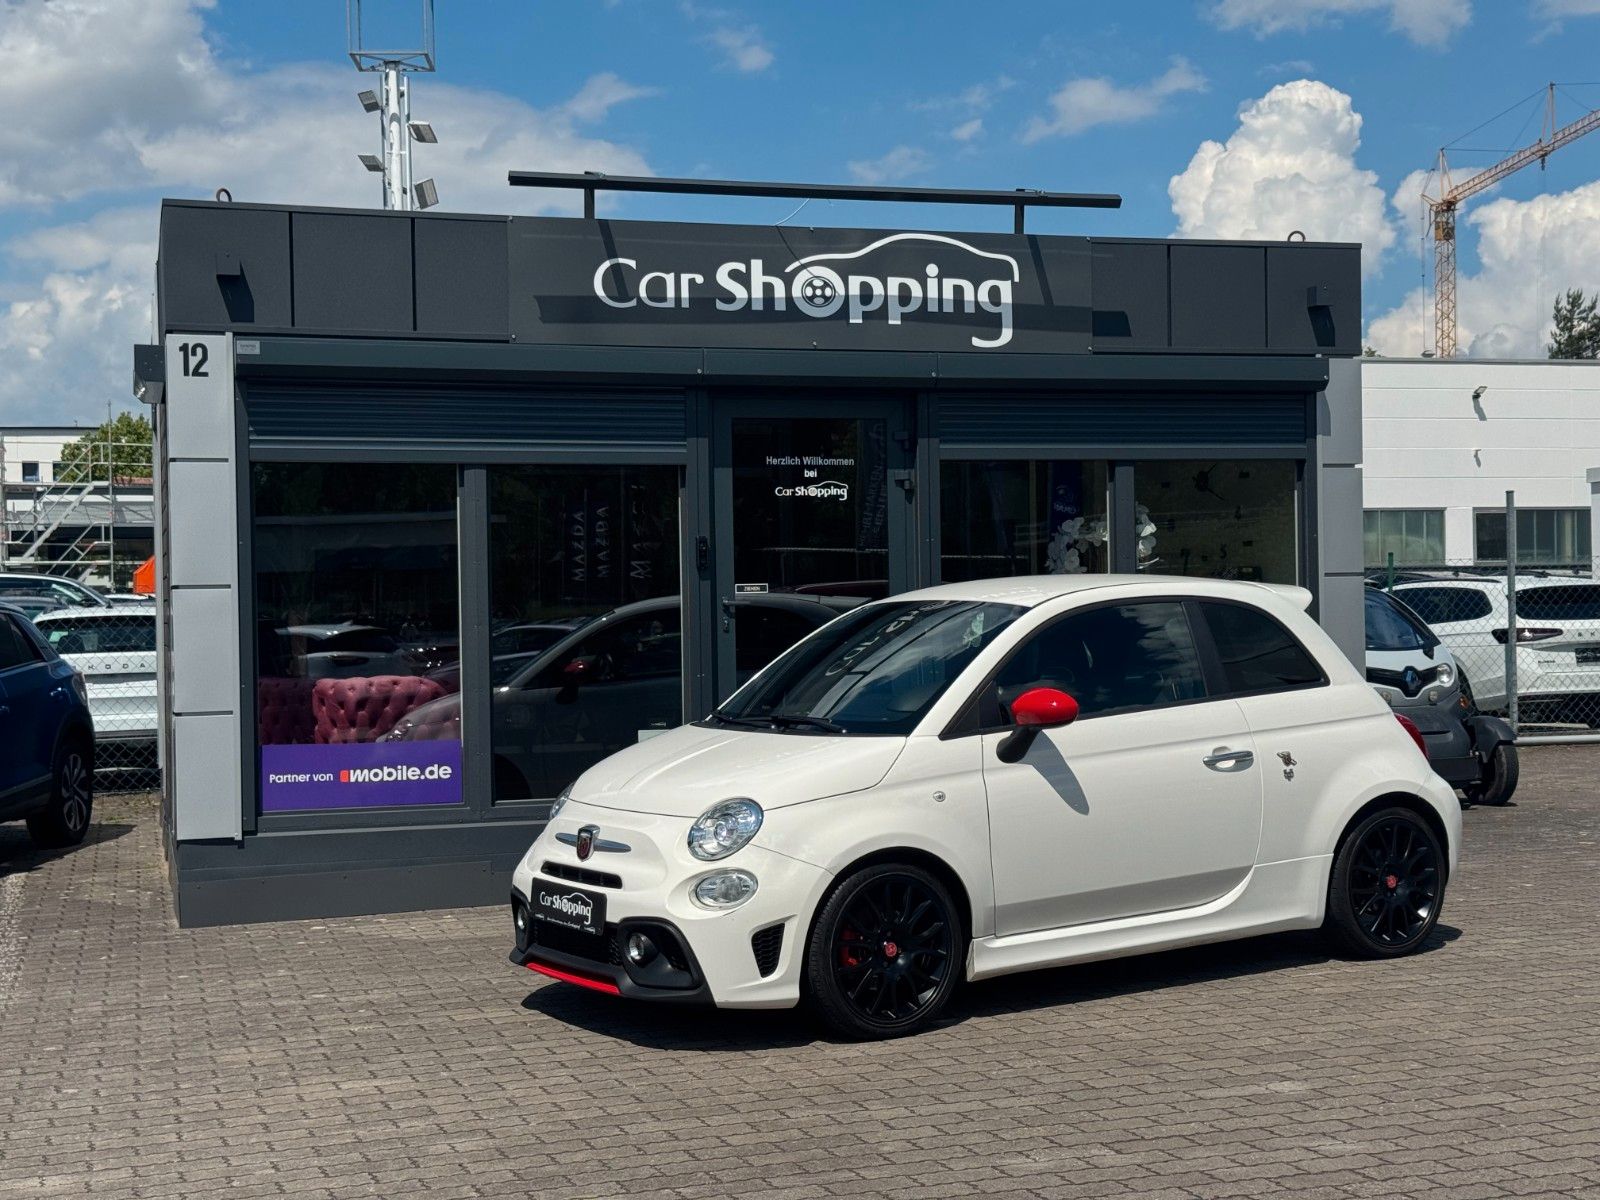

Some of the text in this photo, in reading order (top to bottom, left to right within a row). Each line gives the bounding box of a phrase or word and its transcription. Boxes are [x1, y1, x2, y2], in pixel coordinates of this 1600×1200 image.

[593, 257, 1015, 348] Car Shopping
[179, 343, 209, 377] 12
[765, 456, 855, 466] Herzlich Willkommen
[804, 468, 818, 478] bei
[775, 485, 848, 501] Car Shopping
[571, 511, 585, 582] MAZDA
[87, 661, 146, 670] KODA
[269, 764, 452, 783] Partner von mobile.de
[540, 891, 553, 906] Car
[552, 894, 592, 925] Shopping
